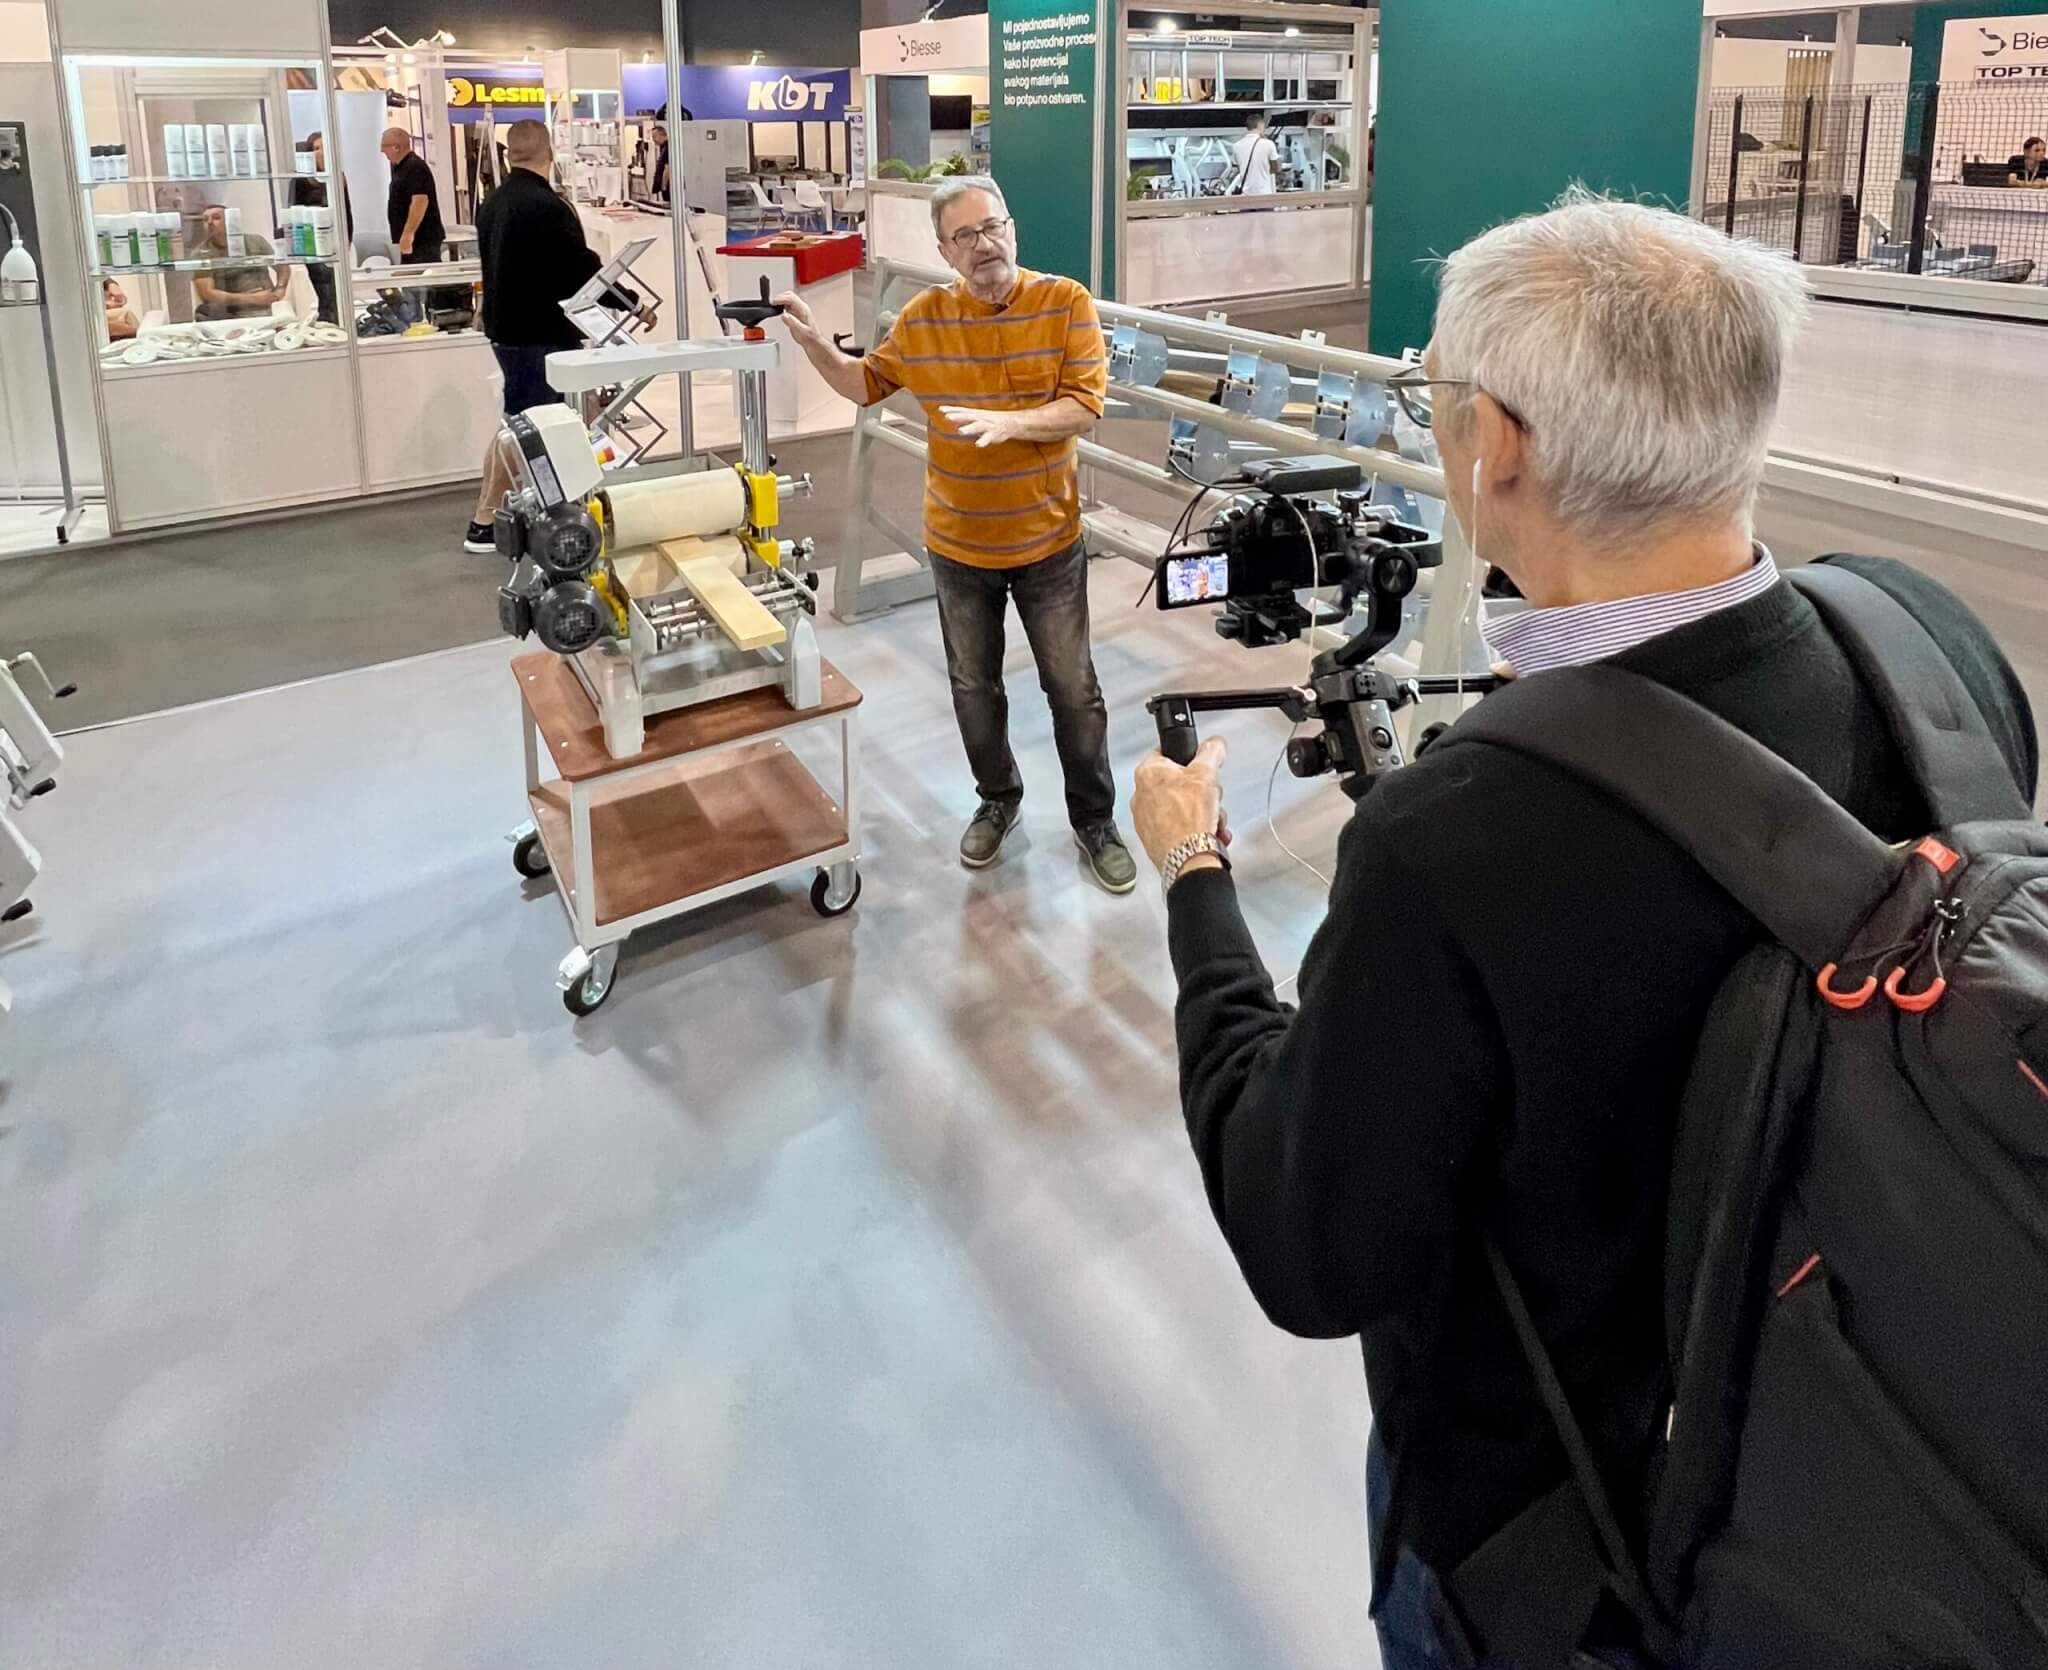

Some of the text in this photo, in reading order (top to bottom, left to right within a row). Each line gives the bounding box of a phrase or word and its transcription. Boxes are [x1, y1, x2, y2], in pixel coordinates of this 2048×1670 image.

[1013, 13, 1089, 35] pojednostavljujemo
[1022, 34, 1064, 53] proizvodne
[1003, 52, 1069, 70] kako bi potencijal
[1030, 72, 1069, 88] materijala
[1976, 67, 2023, 78] TOP
[1003, 93, 1015, 105] bio
[1016, 93, 1047, 107] potpuno
